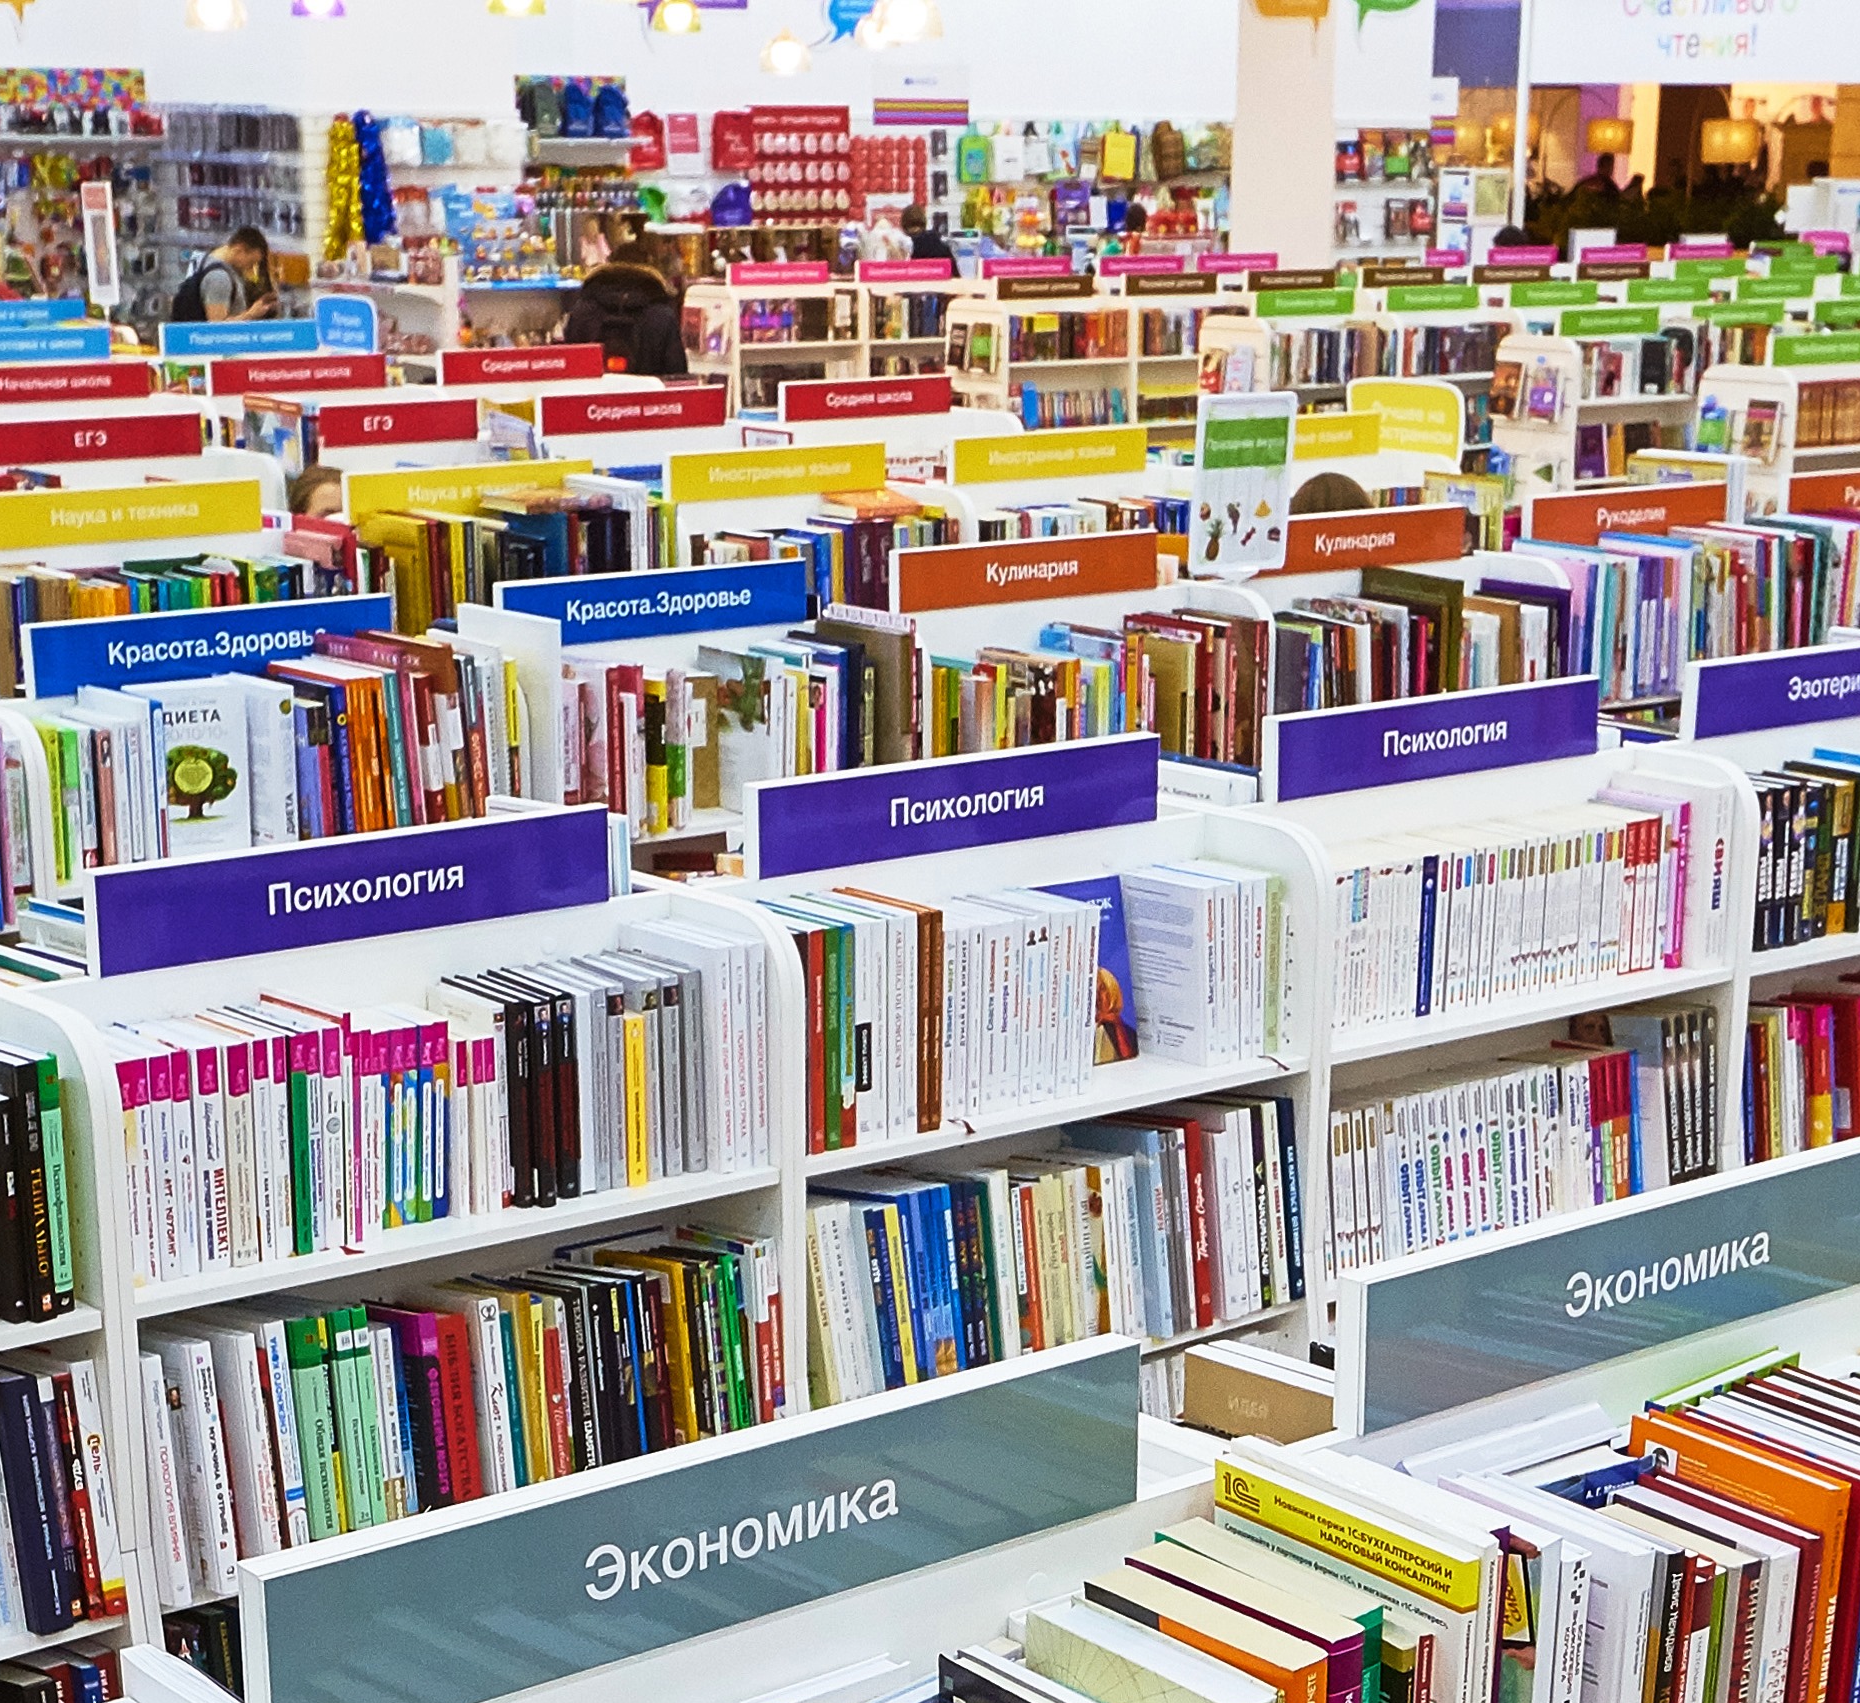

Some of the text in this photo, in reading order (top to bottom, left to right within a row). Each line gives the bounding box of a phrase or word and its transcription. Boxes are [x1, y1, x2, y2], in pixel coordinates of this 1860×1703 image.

[1658, 33, 1757, 59] чтения!
[249, 367, 351, 381] Начальная школа
[531, 359, 566, 369] школа
[0, 376, 111, 390] Начальная школа
[644, 403, 682, 416] школа
[877, 392, 912, 403] школа
[364, 416, 393, 431] ЕГЭ
[74, 430, 107, 447] ЕГЭ
[51, 504, 199, 528] Наука и техника
[1597, 508, 1665, 528] Рукоделие
[1315, 532, 1395, 556] Кулинария
[987, 561, 1078, 586] Кулинария
[567, 589, 751, 625] Красота.Здоровье
[162, 705, 222, 727] ДИЕТА
[1384, 722, 1507, 757] Психология
[891, 786, 1043, 826] Психология
[269, 866, 463, 915] Психология
[1566, 1232, 1769, 1317] Экономика
[586, 1480, 898, 1600] Экономика
[1319, 1528, 1453, 1596] НАЛОГОВЫЙ КОНСАЛТИНГ
